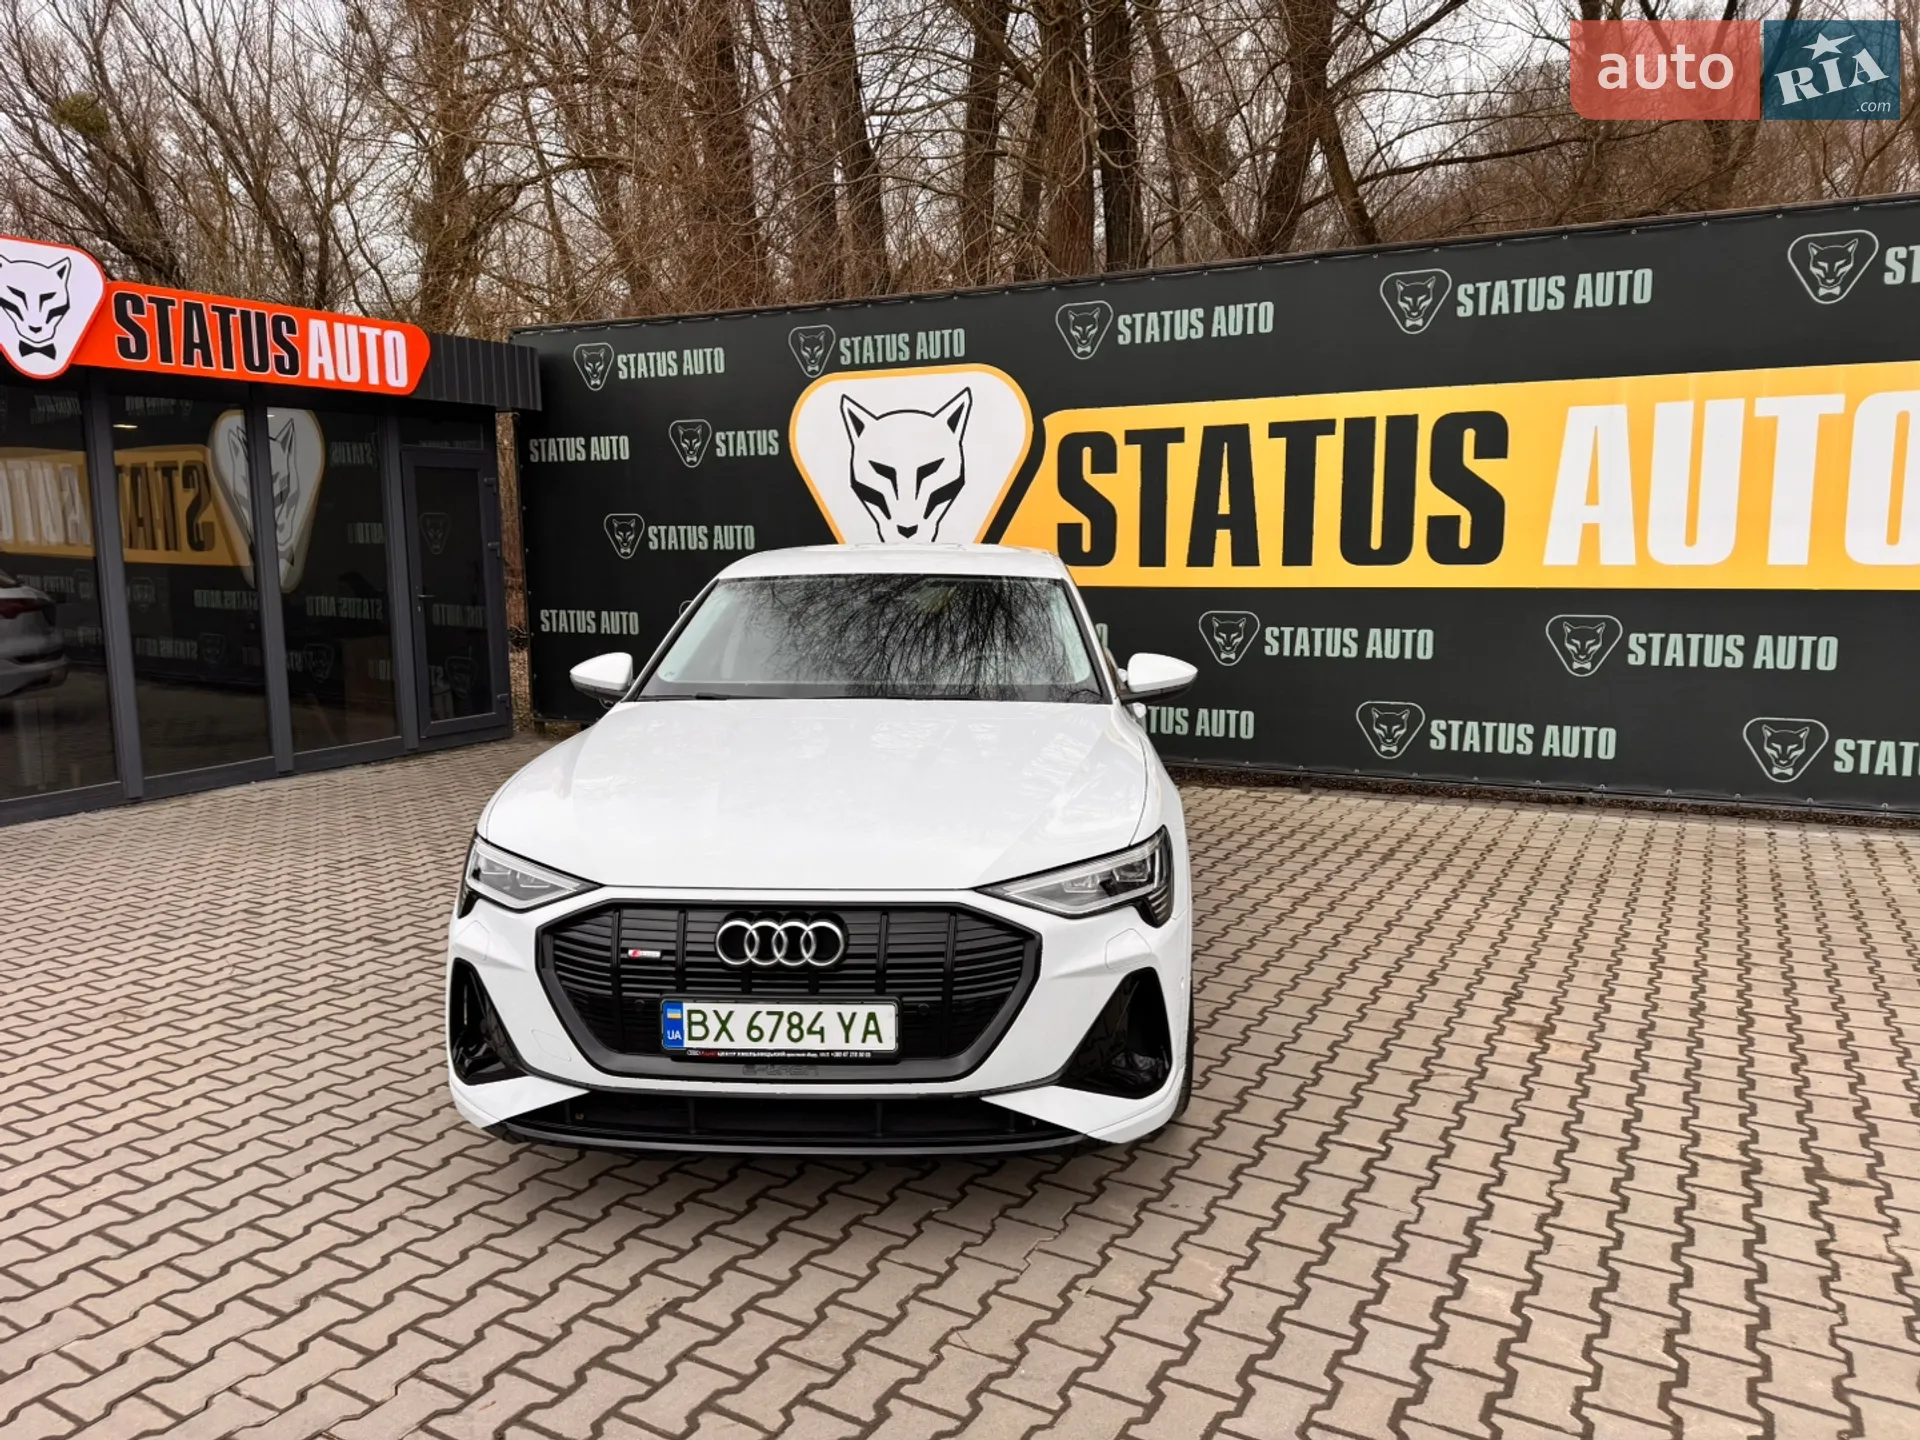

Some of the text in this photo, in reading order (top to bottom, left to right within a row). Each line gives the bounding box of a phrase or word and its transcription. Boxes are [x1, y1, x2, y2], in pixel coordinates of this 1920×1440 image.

[1456, 268, 1654, 318] STATUS AUTO
[111, 291, 408, 388] STATUS AUTO
[1117, 301, 1275, 345] STATUS AUTO
[617, 346, 726, 380] STATUS AUTO
[839, 328, 966, 365] STATUS AUTO
[529, 435, 630, 463] STATUS AUTO
[715, 429, 779, 458] STATUS
[1057, 389, 1920, 568] STATUS AUTO
[647, 524, 756, 551] STATUS AUTO
[540, 609, 640, 635] STATUS AUTO
[1264, 626, 1435, 660] STATUS AUTO
[1627, 632, 1839, 671] STATUS AUTO
[1142, 705, 1256, 740] TUS AUTO
[1429, 719, 1618, 760] STATUS AUTO
[1833, 738, 1920, 777] STAT
[666, 1029, 682, 1041] UA
[687, 1009, 884, 1044] BX 6784 YA
